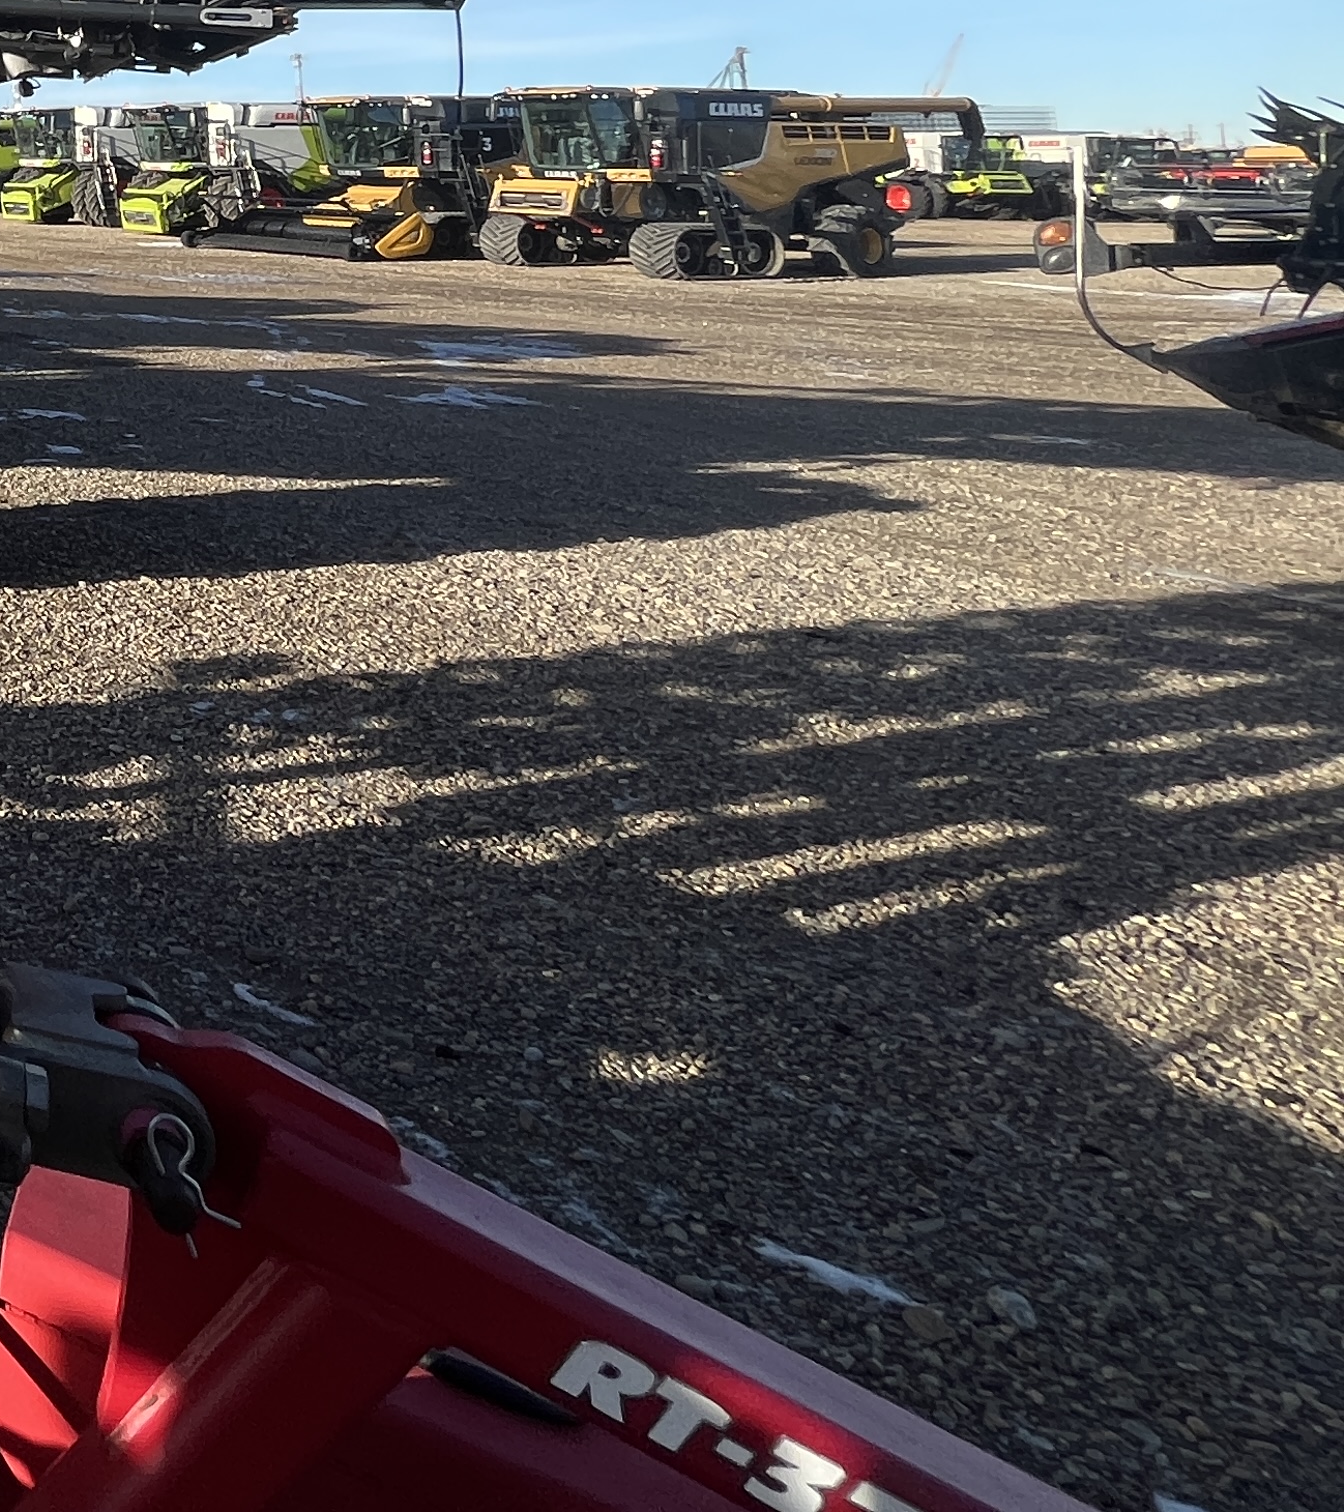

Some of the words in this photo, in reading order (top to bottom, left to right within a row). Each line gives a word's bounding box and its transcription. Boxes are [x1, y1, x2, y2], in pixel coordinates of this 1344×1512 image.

[708, 102, 764, 117] CLAAS
[482, 137, 492, 151] 3
[549, 1339, 924, 1512] RT-3
